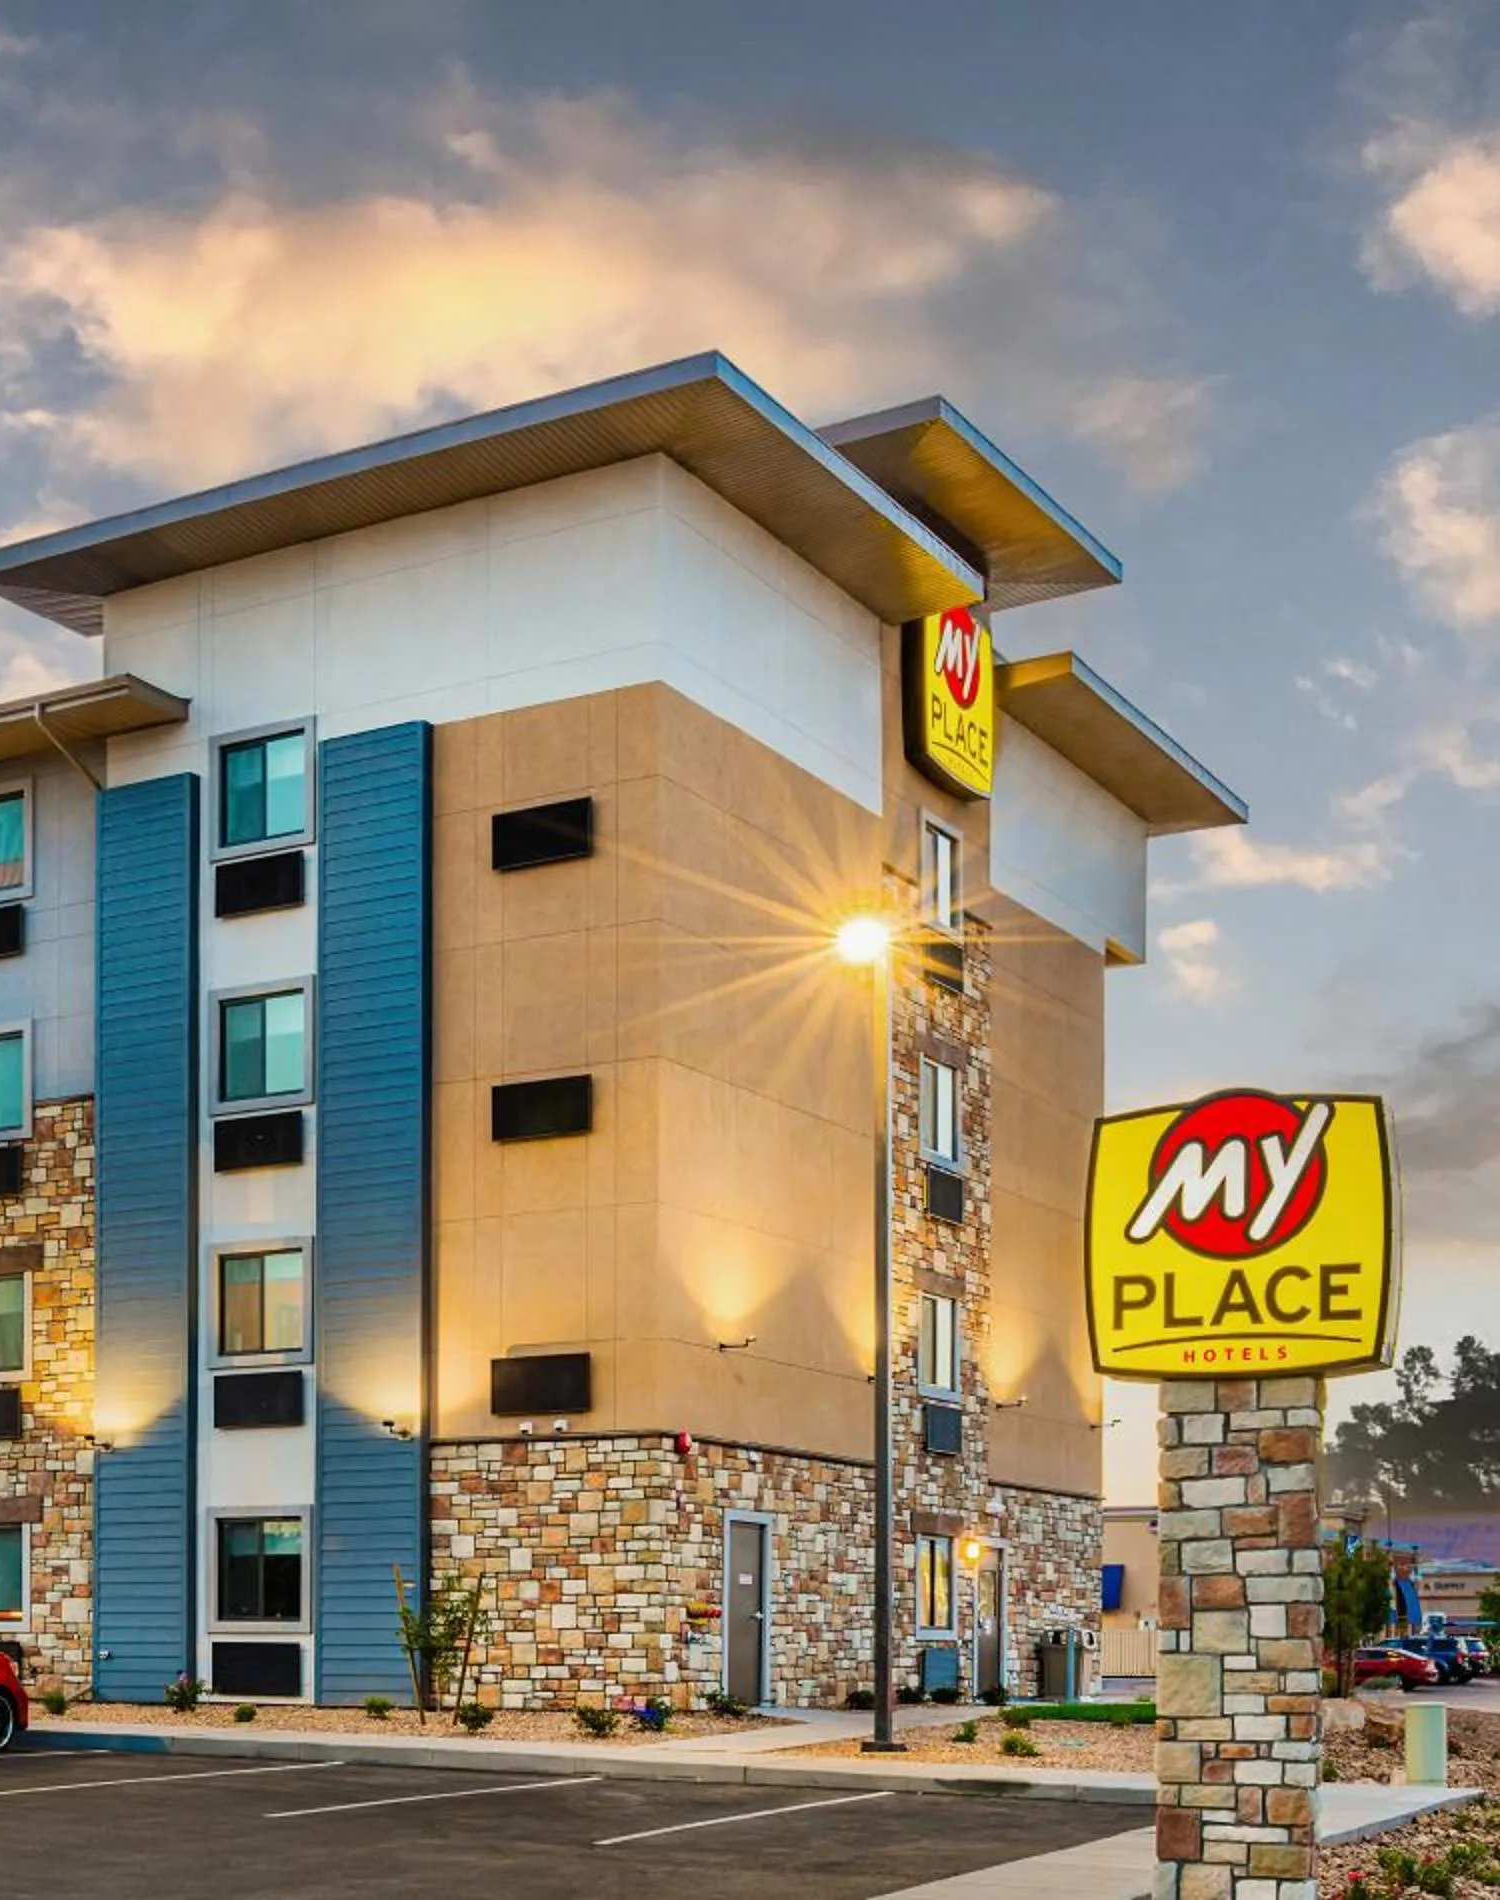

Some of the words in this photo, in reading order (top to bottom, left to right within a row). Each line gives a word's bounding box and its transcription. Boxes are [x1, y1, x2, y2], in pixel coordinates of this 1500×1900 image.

[931, 696, 989, 768] PLACE
[1112, 1262, 1362, 1331] PLACE
[1183, 1345, 1288, 1364] HOTELS
